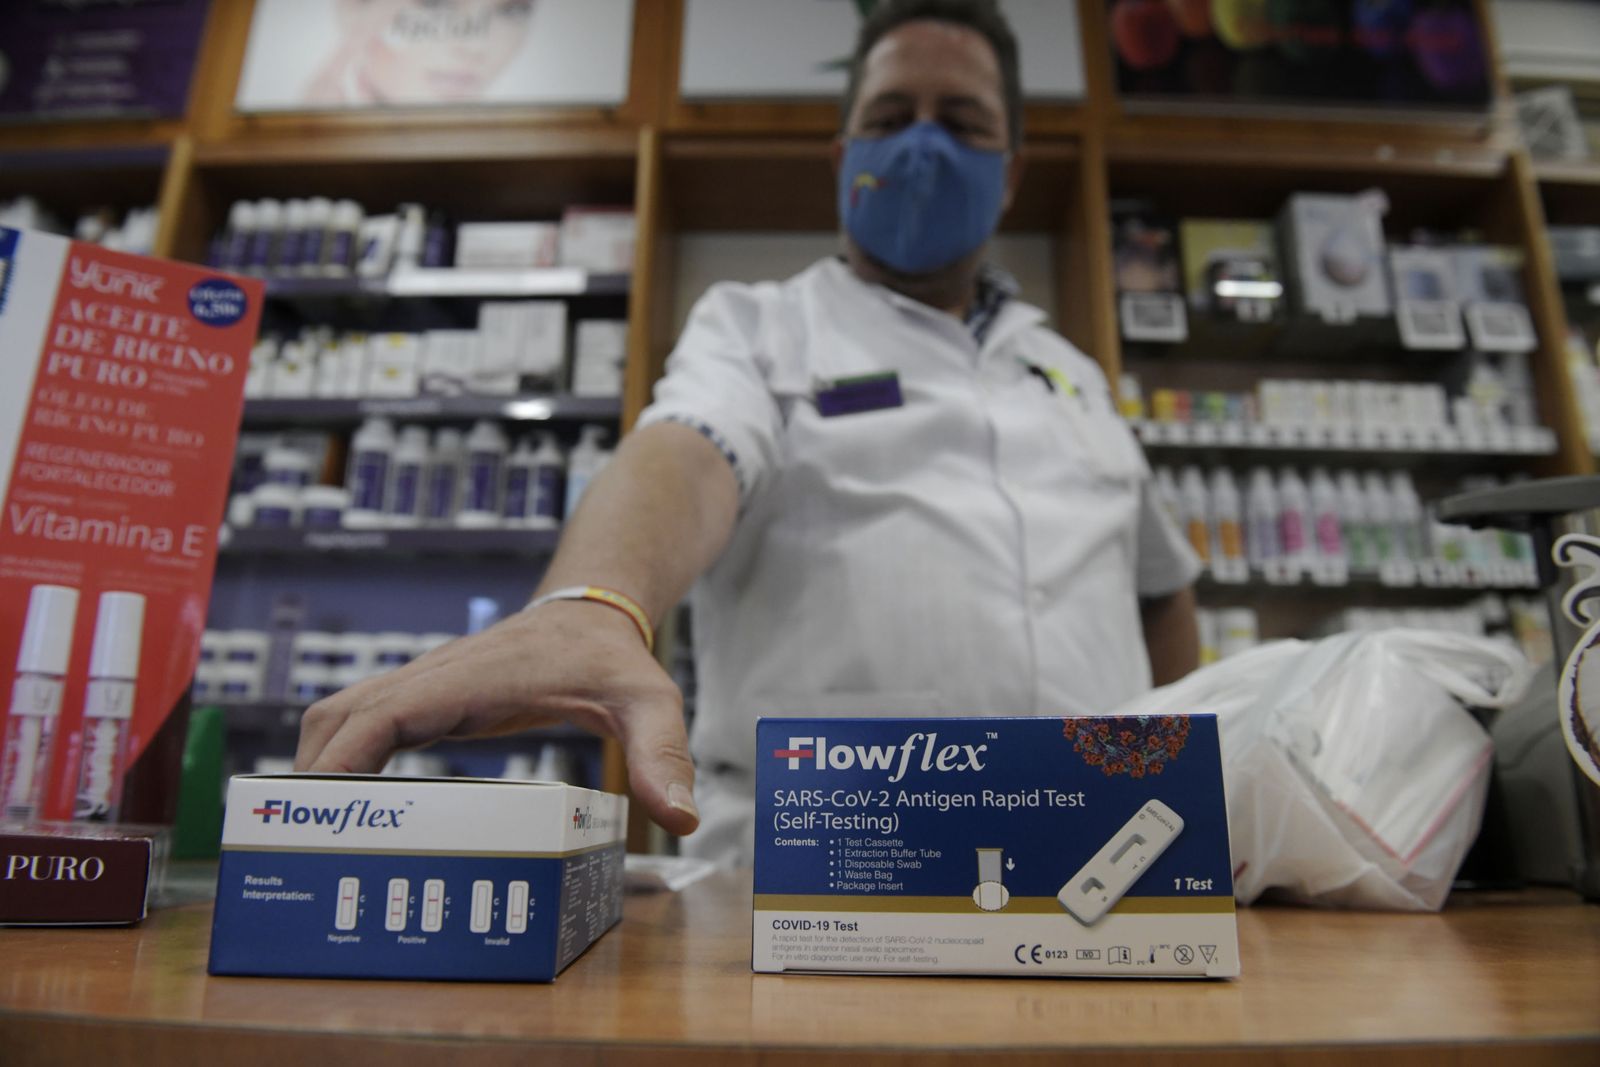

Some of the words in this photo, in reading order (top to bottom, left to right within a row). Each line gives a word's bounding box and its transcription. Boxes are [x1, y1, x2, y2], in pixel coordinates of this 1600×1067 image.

[61, 298, 190, 341] ACEITE
[53, 325, 104, 355] DE
[113, 333, 235, 376] RICINO
[47, 352, 148, 389] PURO
[25, 441, 172, 476] REGENERADOR
[20, 461, 177, 497] FORTALECEDOR
[10, 504, 173, 553] Vitamina
[182, 524, 209, 558] E
[774, 732, 988, 783] Flowflex
[774, 790, 890, 807] SARS-CoV-2
[896, 790, 975, 811] Antigen
[982, 790, 1039, 811] Rapid
[1044, 790, 1085, 807] Test
[253, 800, 405, 834] Flowflex
[774, 812, 899, 833] (Self-Testing)
[774, 838, 819, 847] Contents:
[837, 838, 842, 846] 1
[845, 838, 862, 846] Test
[864, 838, 903, 847] Cassette
[837, 849, 842, 857] 1
[845, 849, 889, 857] Extraction
[890, 849, 918, 857] Buffer
[919, 849, 941, 858] Tube
[4, 855, 105, 881] PURO
[837, 860, 842, 868] 1
[845, 860, 895, 869] Disposable
[896, 860, 922, 868] Swab
[244, 875, 283, 887] Results
[837, 870, 842, 879] 1
[845, 871, 872, 879] Waste
[874, 871, 892, 881] Bag
[837, 881, 876, 891] Package
[878, 881, 903, 890] Insert
[1174, 878, 1180, 889] 1
[1184, 878, 1213, 890] Test
[243, 889, 315, 902] Interpretation:
[772, 919, 830, 931] COVID-19
[833, 920, 858, 932] Test
[327, 934, 360, 944] Negative
[397, 936, 427, 945] Positive
[485, 937, 510, 946] Invalid
[839, 936, 873, 944] detection
[1045, 950, 1068, 959] 0123
